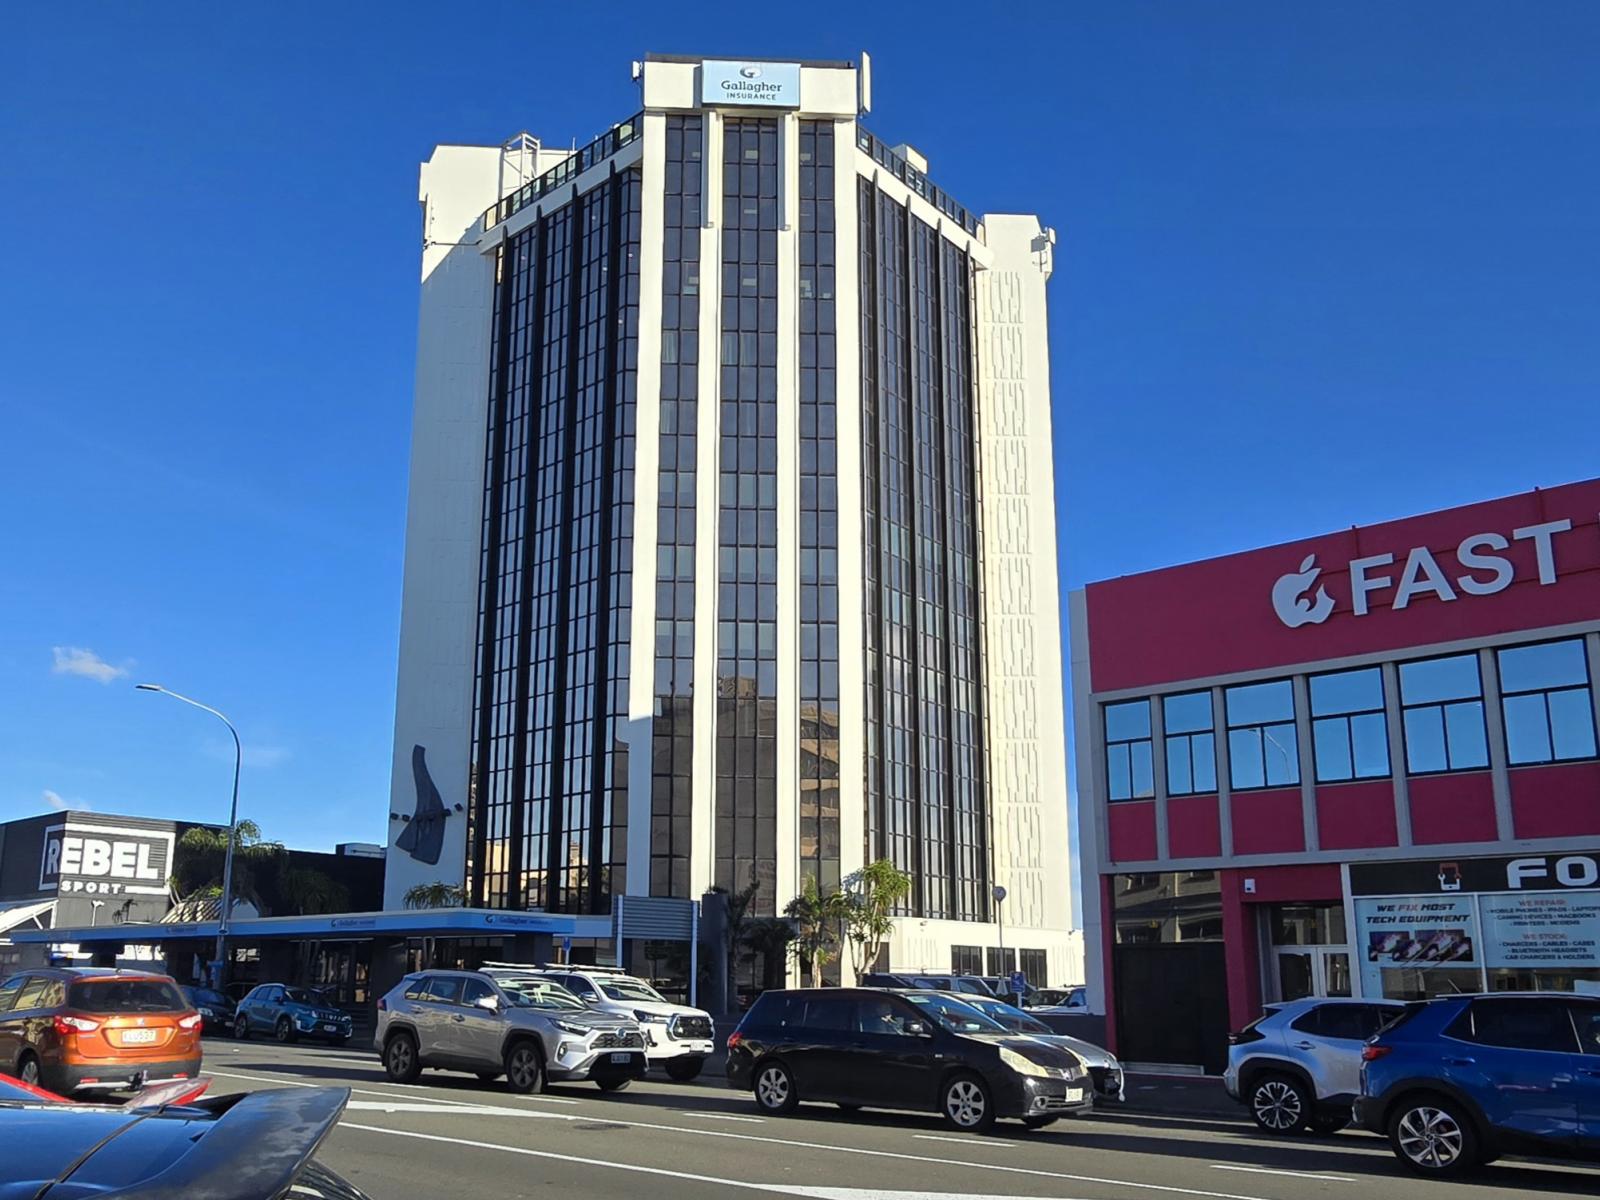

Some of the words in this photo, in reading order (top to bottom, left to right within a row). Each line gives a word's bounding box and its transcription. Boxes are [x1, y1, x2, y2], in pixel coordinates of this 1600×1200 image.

[721, 80, 782, 93] Gallagher
[727, 92, 776, 101] INSURANCE
[1349, 518, 1572, 616] FAST
[46, 837, 159, 880] REBEL
[60, 880, 121, 894] SPORT
[1398, 904, 1418, 912] FIX
[1421, 903, 1455, 911] MOST
[1366, 916, 1396, 924] TECH
[1398, 914, 1470, 923] EQUIPMENT
